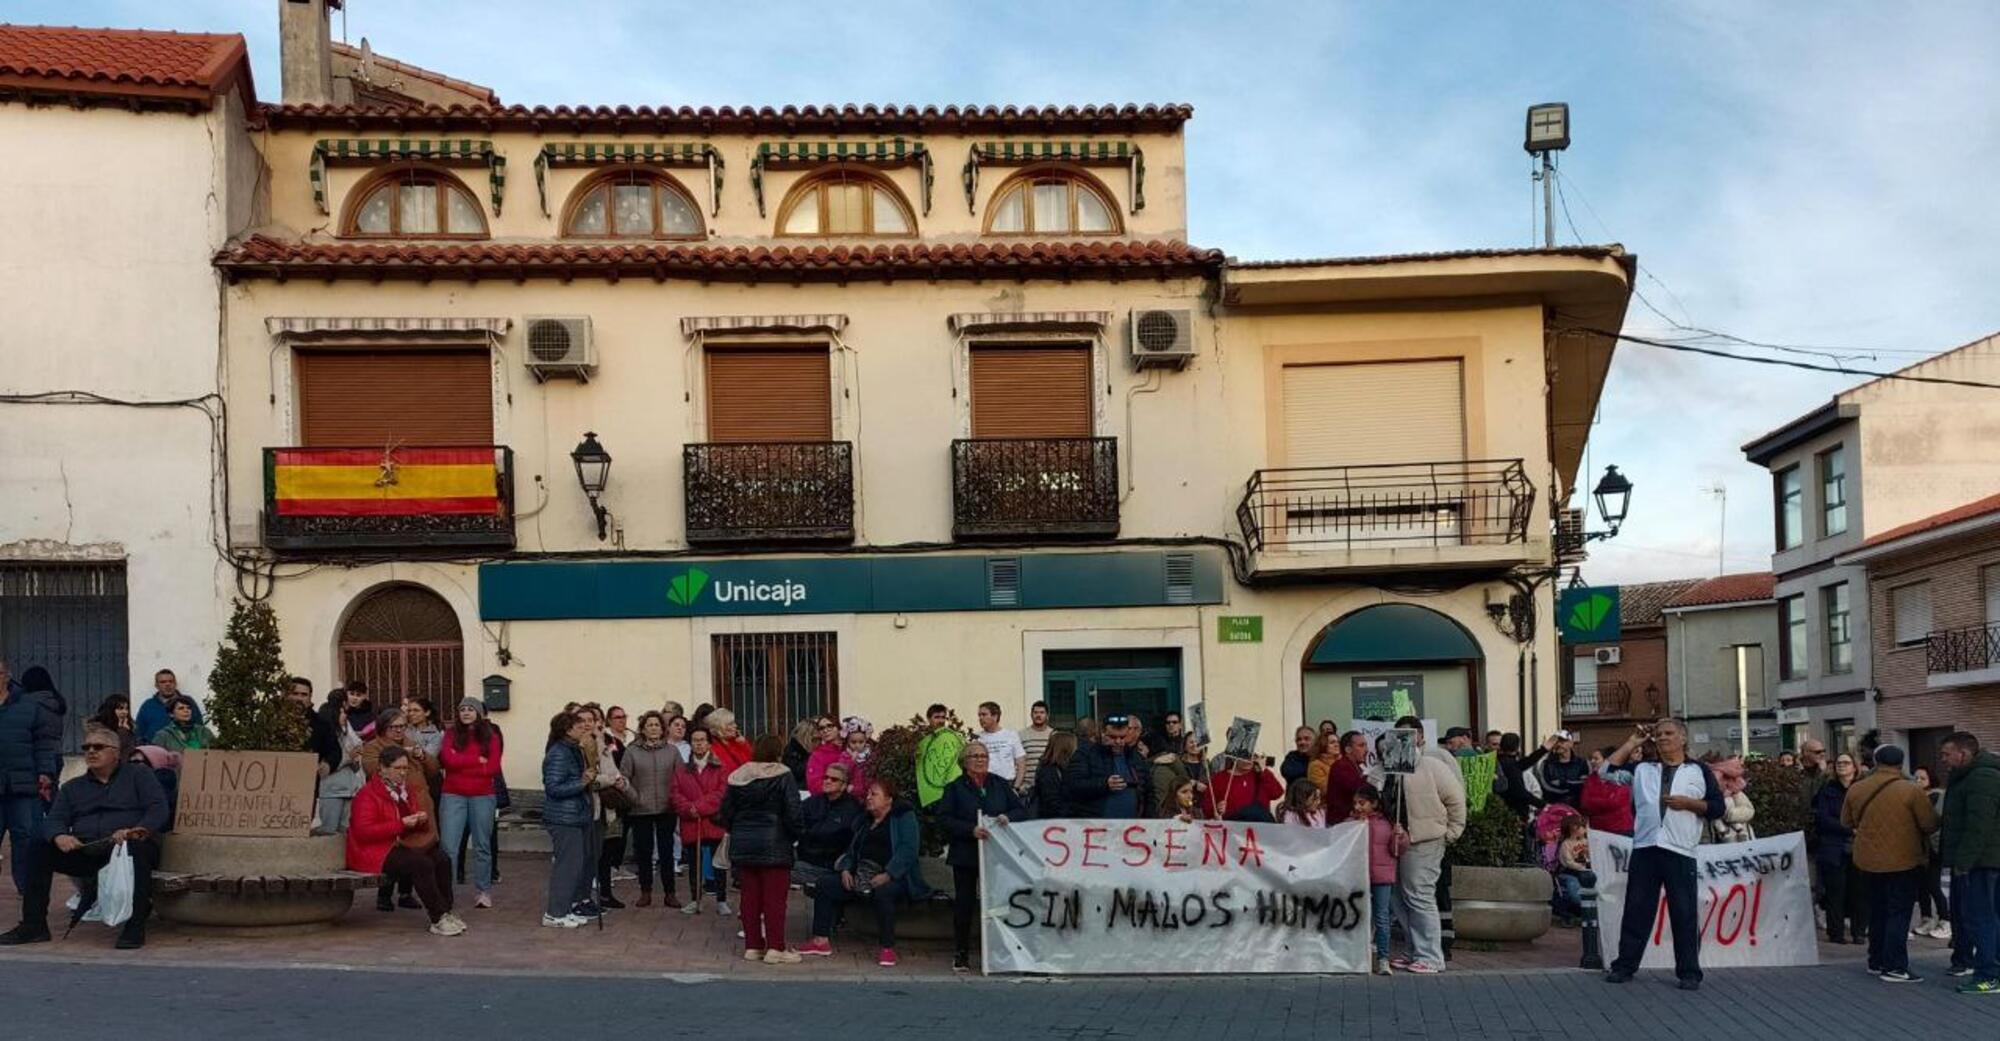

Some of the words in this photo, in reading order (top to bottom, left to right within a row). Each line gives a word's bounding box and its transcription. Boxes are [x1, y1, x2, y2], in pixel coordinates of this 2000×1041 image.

[715, 579, 806, 606] Unicaja
[179, 791, 190, 811] A
[194, 792, 213, 811] LA
[217, 793, 273, 812] PLANTA
[176, 812, 234, 829] ASFALTO
[238, 813, 257, 829] EN
[1042, 824, 1264, 868] SESEÑA
[1706, 851, 1792, 880] ASFALTO
[1003, 889, 1083, 930] SIN
[1108, 888, 1235, 930] MALOS
[1257, 889, 1364, 931] HUMOS
